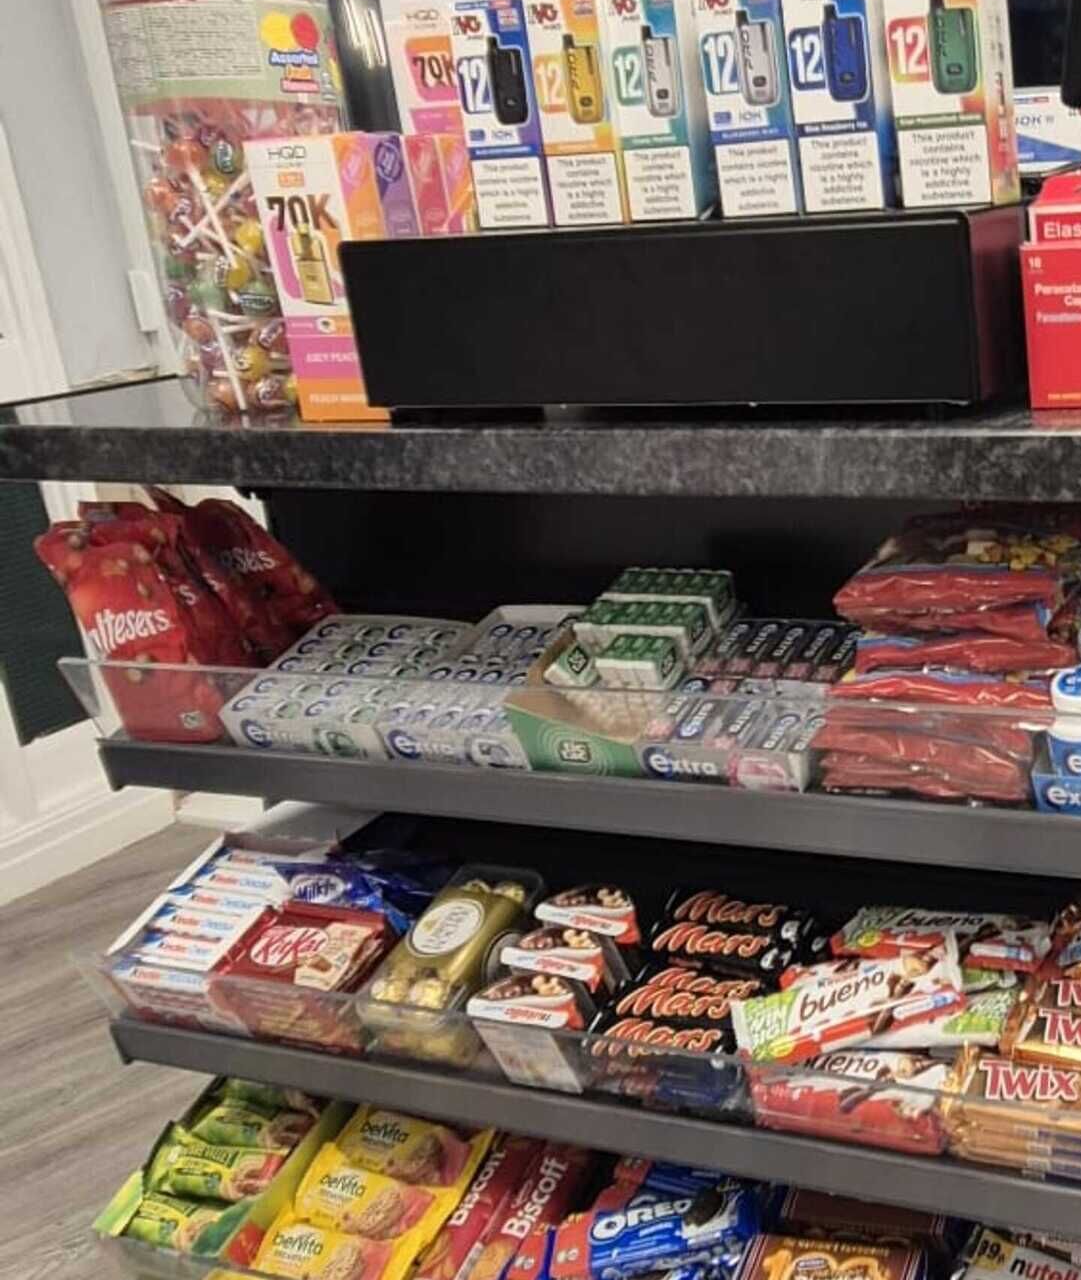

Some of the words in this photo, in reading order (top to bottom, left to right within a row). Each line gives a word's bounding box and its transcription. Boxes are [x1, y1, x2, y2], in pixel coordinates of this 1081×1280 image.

[703, 33, 739, 90] 12
[791, 34, 824, 86] 12
[892, 23, 928, 77] 12
[459, 57, 492, 114] 12
[536, 59, 563, 107] 12
[614, 51, 643, 100] 12
[267, 194, 339, 231] 70K
[650, 752, 718, 776] extra
[673, 890, 788, 927] Mars
[254, 928, 327, 964] KitKat
[652, 922, 771, 957] Mars
[616, 984, 732, 1019] Mars
[800, 970, 885, 1021] bueno
[603, 1018, 723, 1053] Mars
[979, 1059, 1078, 1101] Twix
[320, 1173, 367, 1198] belVita
[502, 1158, 568, 1240] Biscoff
[591, 1198, 692, 1240] OREO
[272, 1229, 325, 1257] belVita
